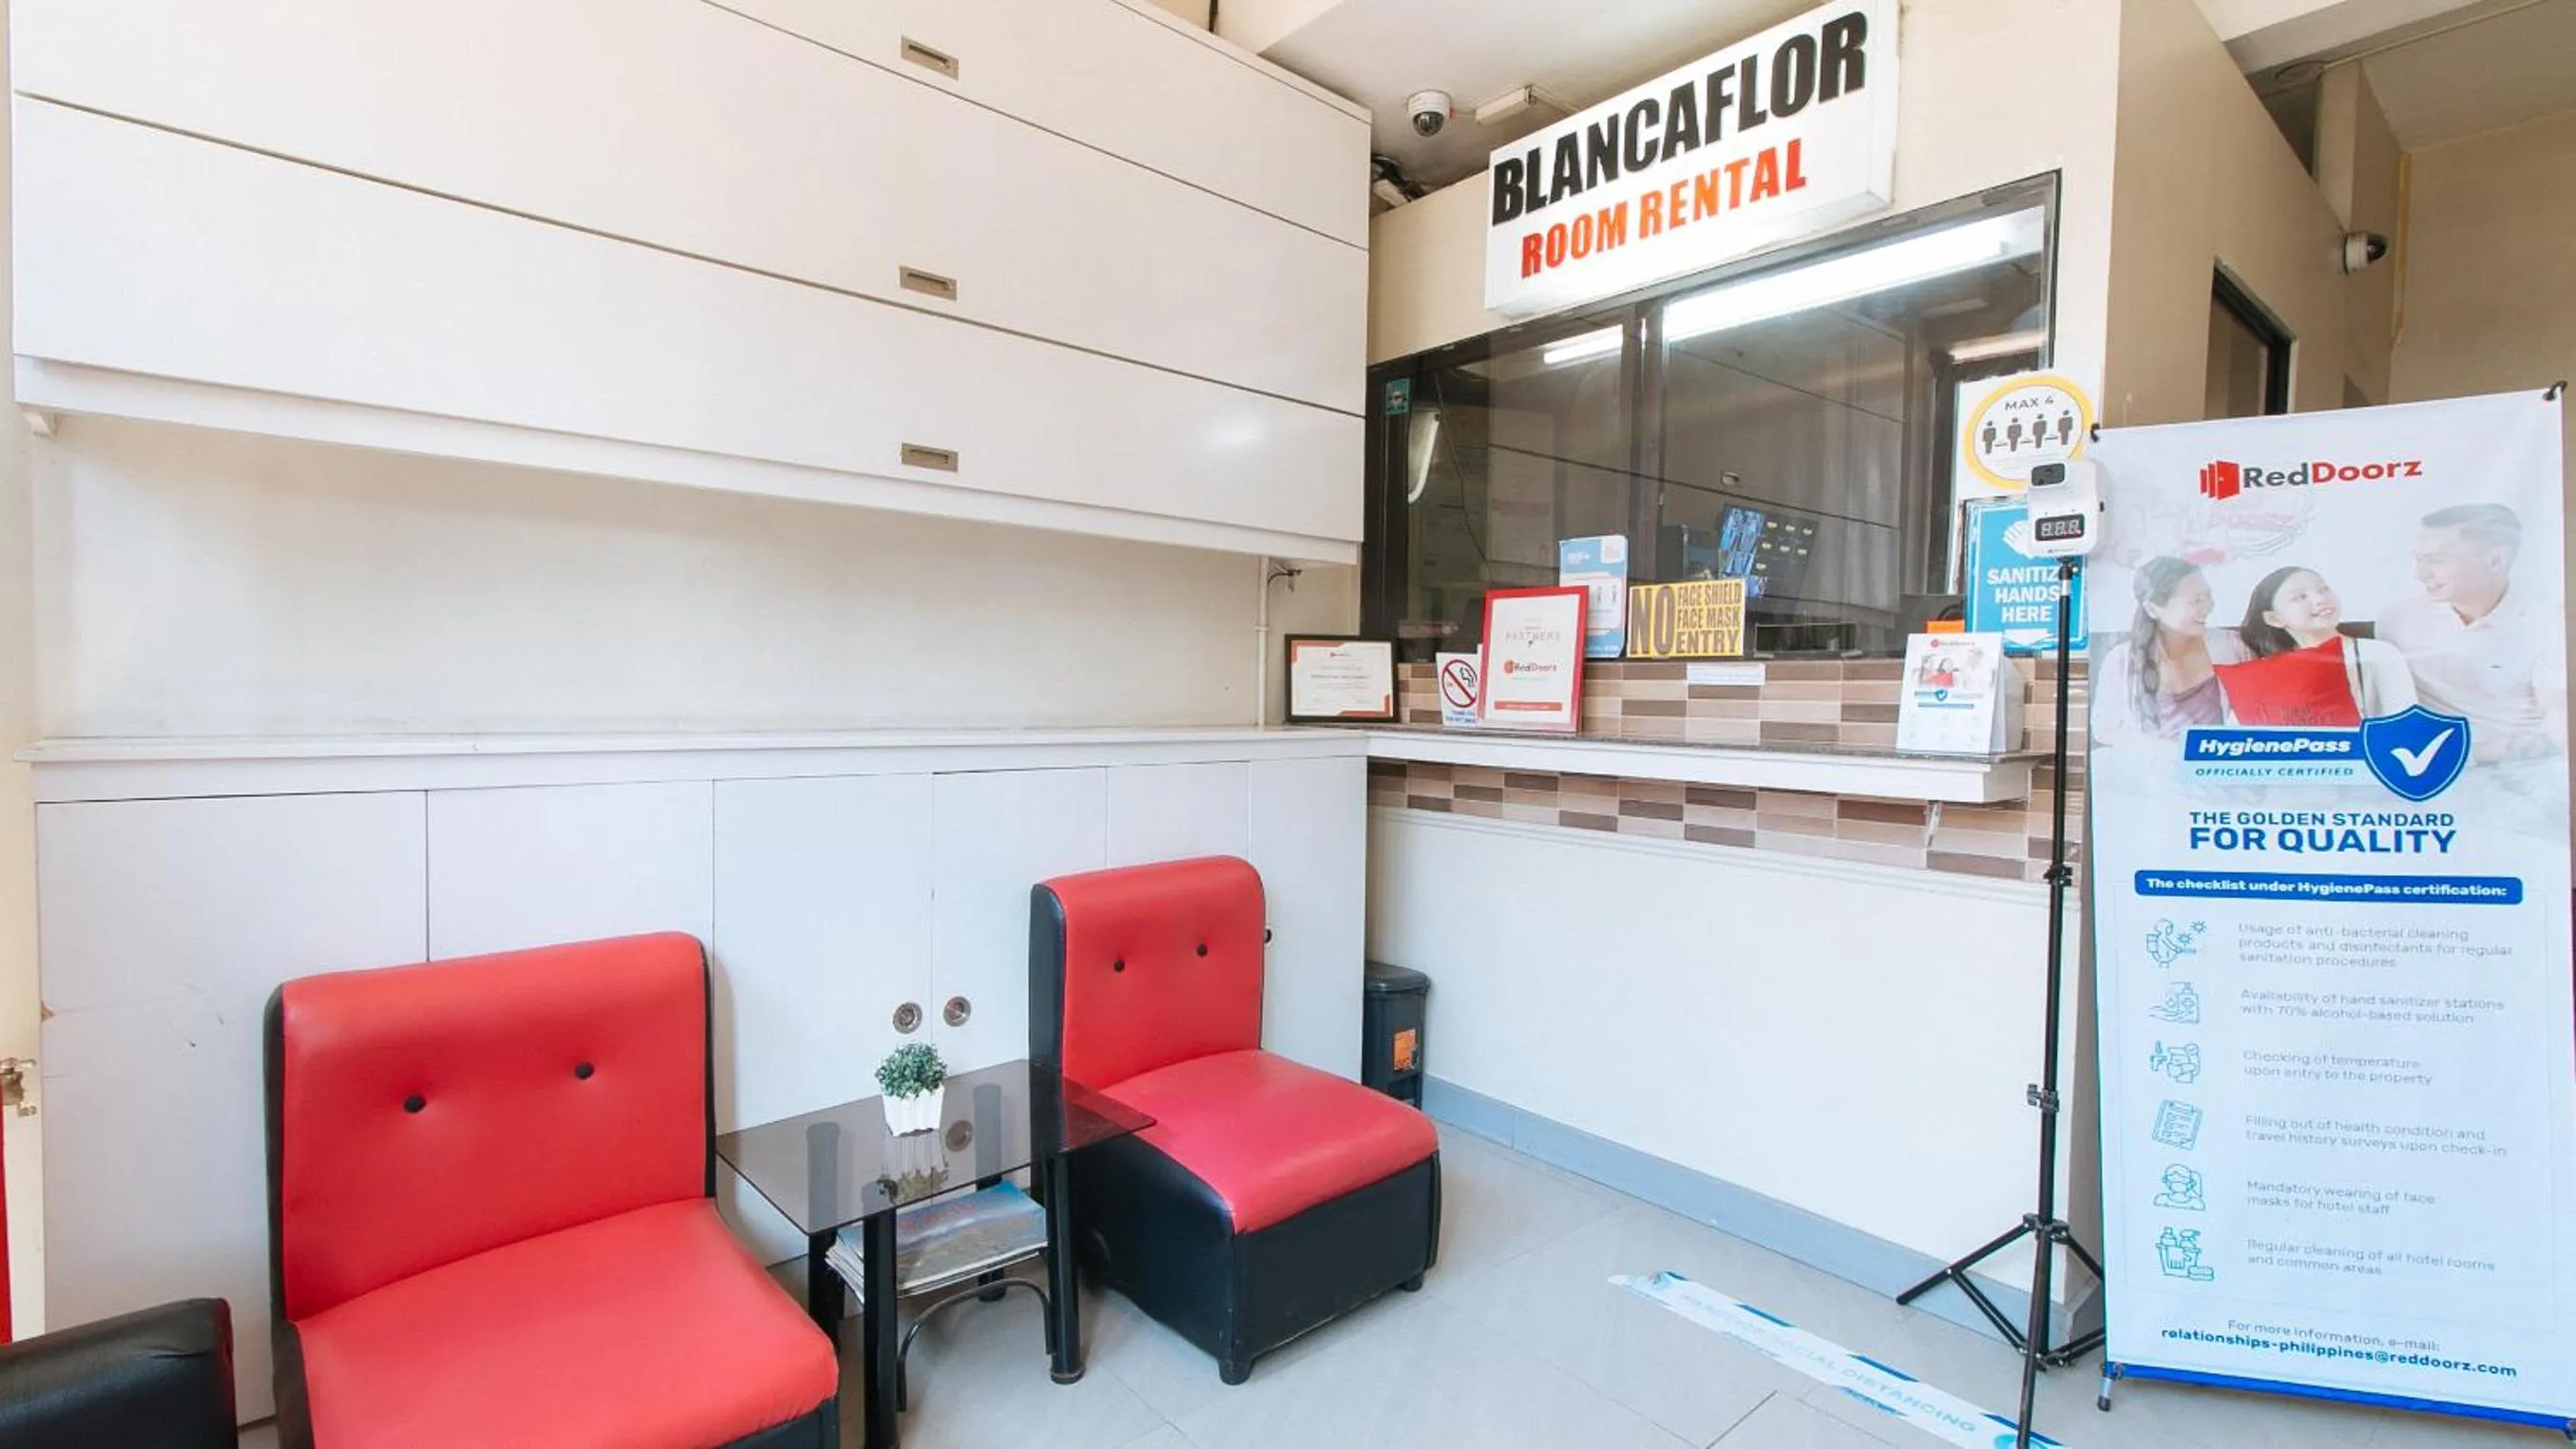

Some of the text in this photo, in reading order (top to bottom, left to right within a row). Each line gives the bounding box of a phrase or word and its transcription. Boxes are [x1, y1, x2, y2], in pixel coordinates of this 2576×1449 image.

[1492, 11, 1867, 226] BLANCAFLOR
[1521, 138, 1807, 278] ROOM RENTAL
[2005, 398, 2039, 410] MAX
[2243, 460, 2423, 487] RedDoorz
[1987, 565, 2060, 584] SANITIZ
[1678, 582, 1741, 606] FACE SHIELD
[1995, 585, 2061, 603] HANDS
[1631, 585, 1675, 655] NO
[1677, 605, 1740, 628] FACE MASK
[2002, 605, 2052, 623] HERE
[1676, 630, 1739, 654] ENTRY
[2199, 737, 2351, 756] HygienePass
[2195, 768, 2355, 777] OFFICIALLY CERTIFIED
[2189, 811, 2454, 827] THE GOLDEN STANDARD
[2190, 828, 2456, 853] FOR QUALITY
[2147, 877, 2507, 897] The checklist under HygienePass certification:
[2239, 923, 2282, 936] Usage
[2286, 925, 2301, 935] of
[2408, 927, 2470, 942] cleaning
[2239, 938, 2513, 956] products and disinfectants for regular
[2239, 953, 2396, 967] sanitation procedures
[2241, 989, 2505, 1010] Availability of hand sanitizer stations
[2242, 1004, 2474, 1023] with 70% alcohol-based solution
[2242, 1051, 2421, 1070] Checking of temperature
[2243, 1065, 2432, 1085] upon entry to the property
[2245, 1115, 2485, 1140] Filling out of health condition and
[2245, 1130, 2508, 1156] travel history surveys upon check-in
[2247, 1180, 2321, 1196] Mandatory
[2324, 1187, 2381, 1201] wearing
[2385, 1189, 2400, 1201] of
[2246, 1196, 2391, 1214] masks for hotel staff
[2247, 1239, 2495, 1271] Regular cleaning of all hotel rooms
[2248, 1254, 2382, 1275] and common areas
[2228, 1320, 2250, 1331] For
[2254, 1324, 2291, 1336] more
[2161, 1327, 2518, 1377] relationships-philippines@reddoorz.com
[1840, 1368, 1977, 1433] DISTANCING
